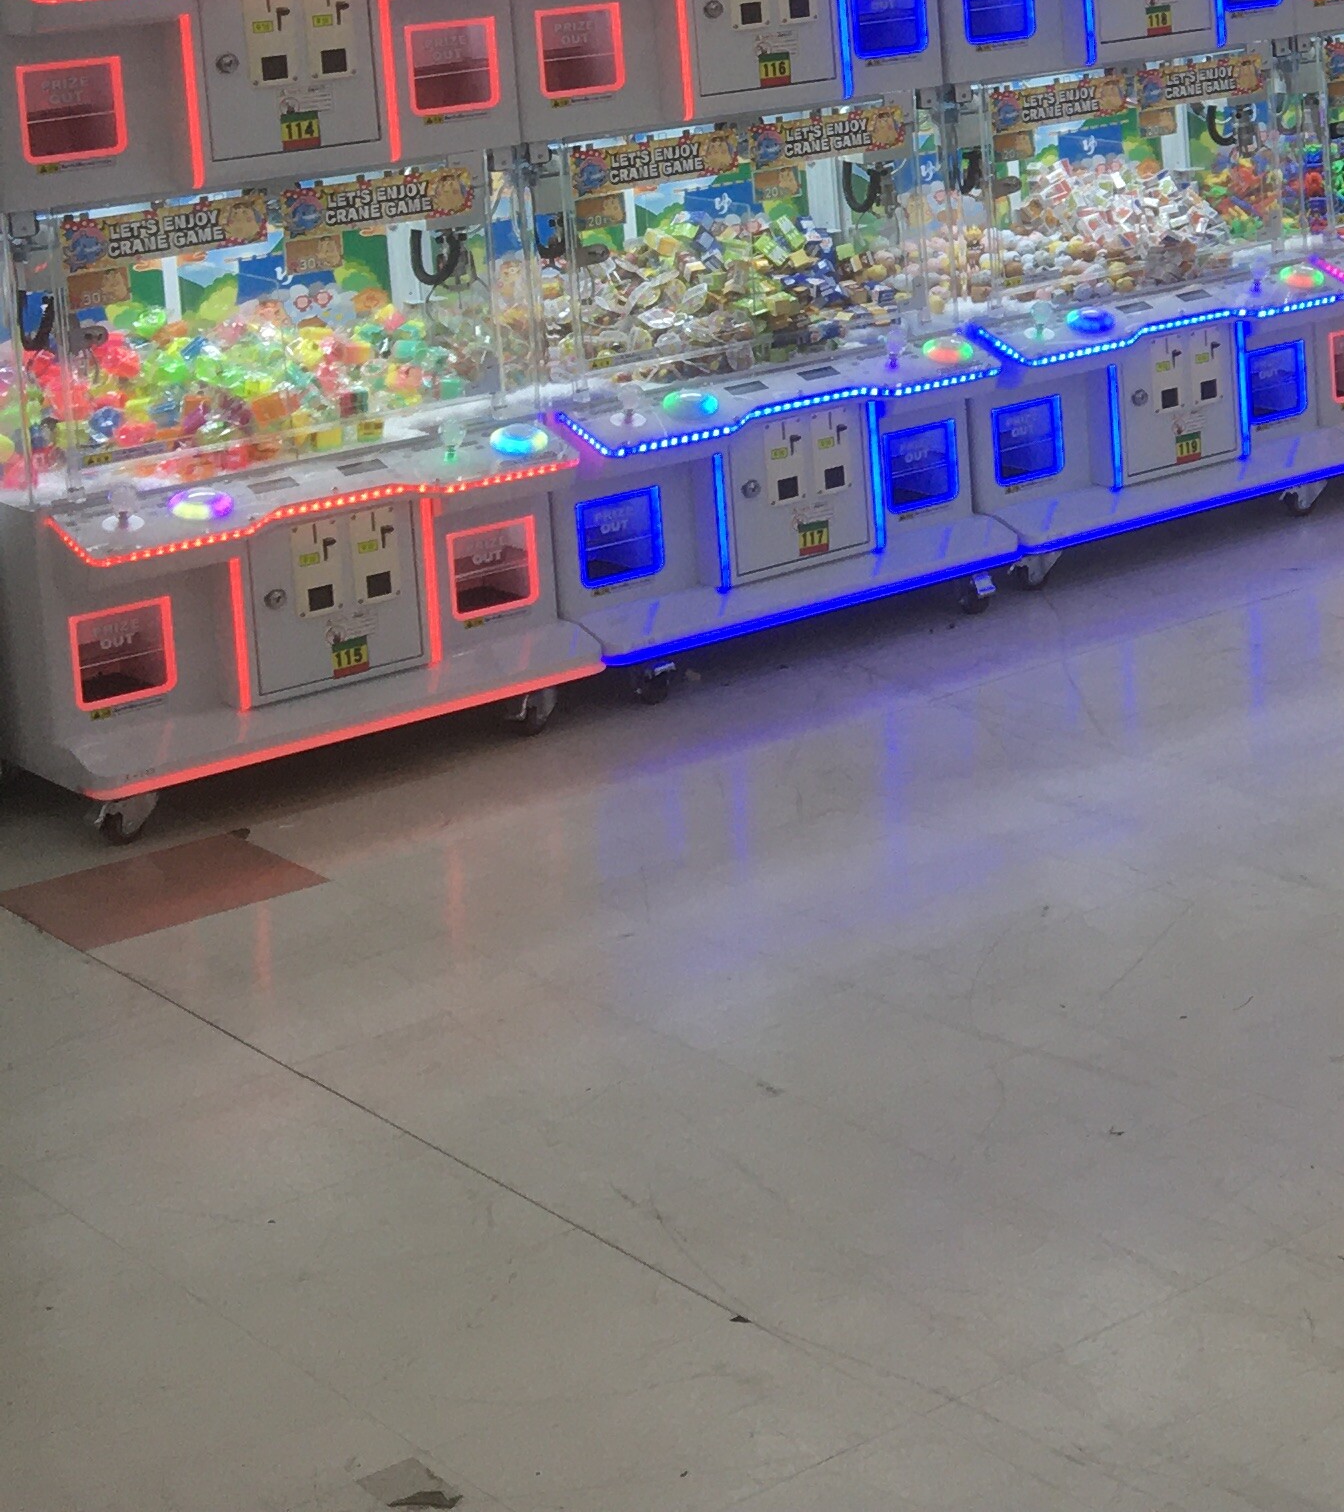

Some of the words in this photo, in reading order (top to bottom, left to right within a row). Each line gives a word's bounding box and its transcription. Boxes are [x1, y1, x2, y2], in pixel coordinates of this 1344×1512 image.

[762, 60, 787, 78] 116
[284, 120, 316, 141] 114
[785, 123, 822, 142] LET'S
[826, 117, 868, 136] ENJOY
[783, 136, 830, 158] CRANE
[832, 131, 871, 150] GAME
[801, 529, 826, 546] 117
[334, 647, 364, 667] 115
